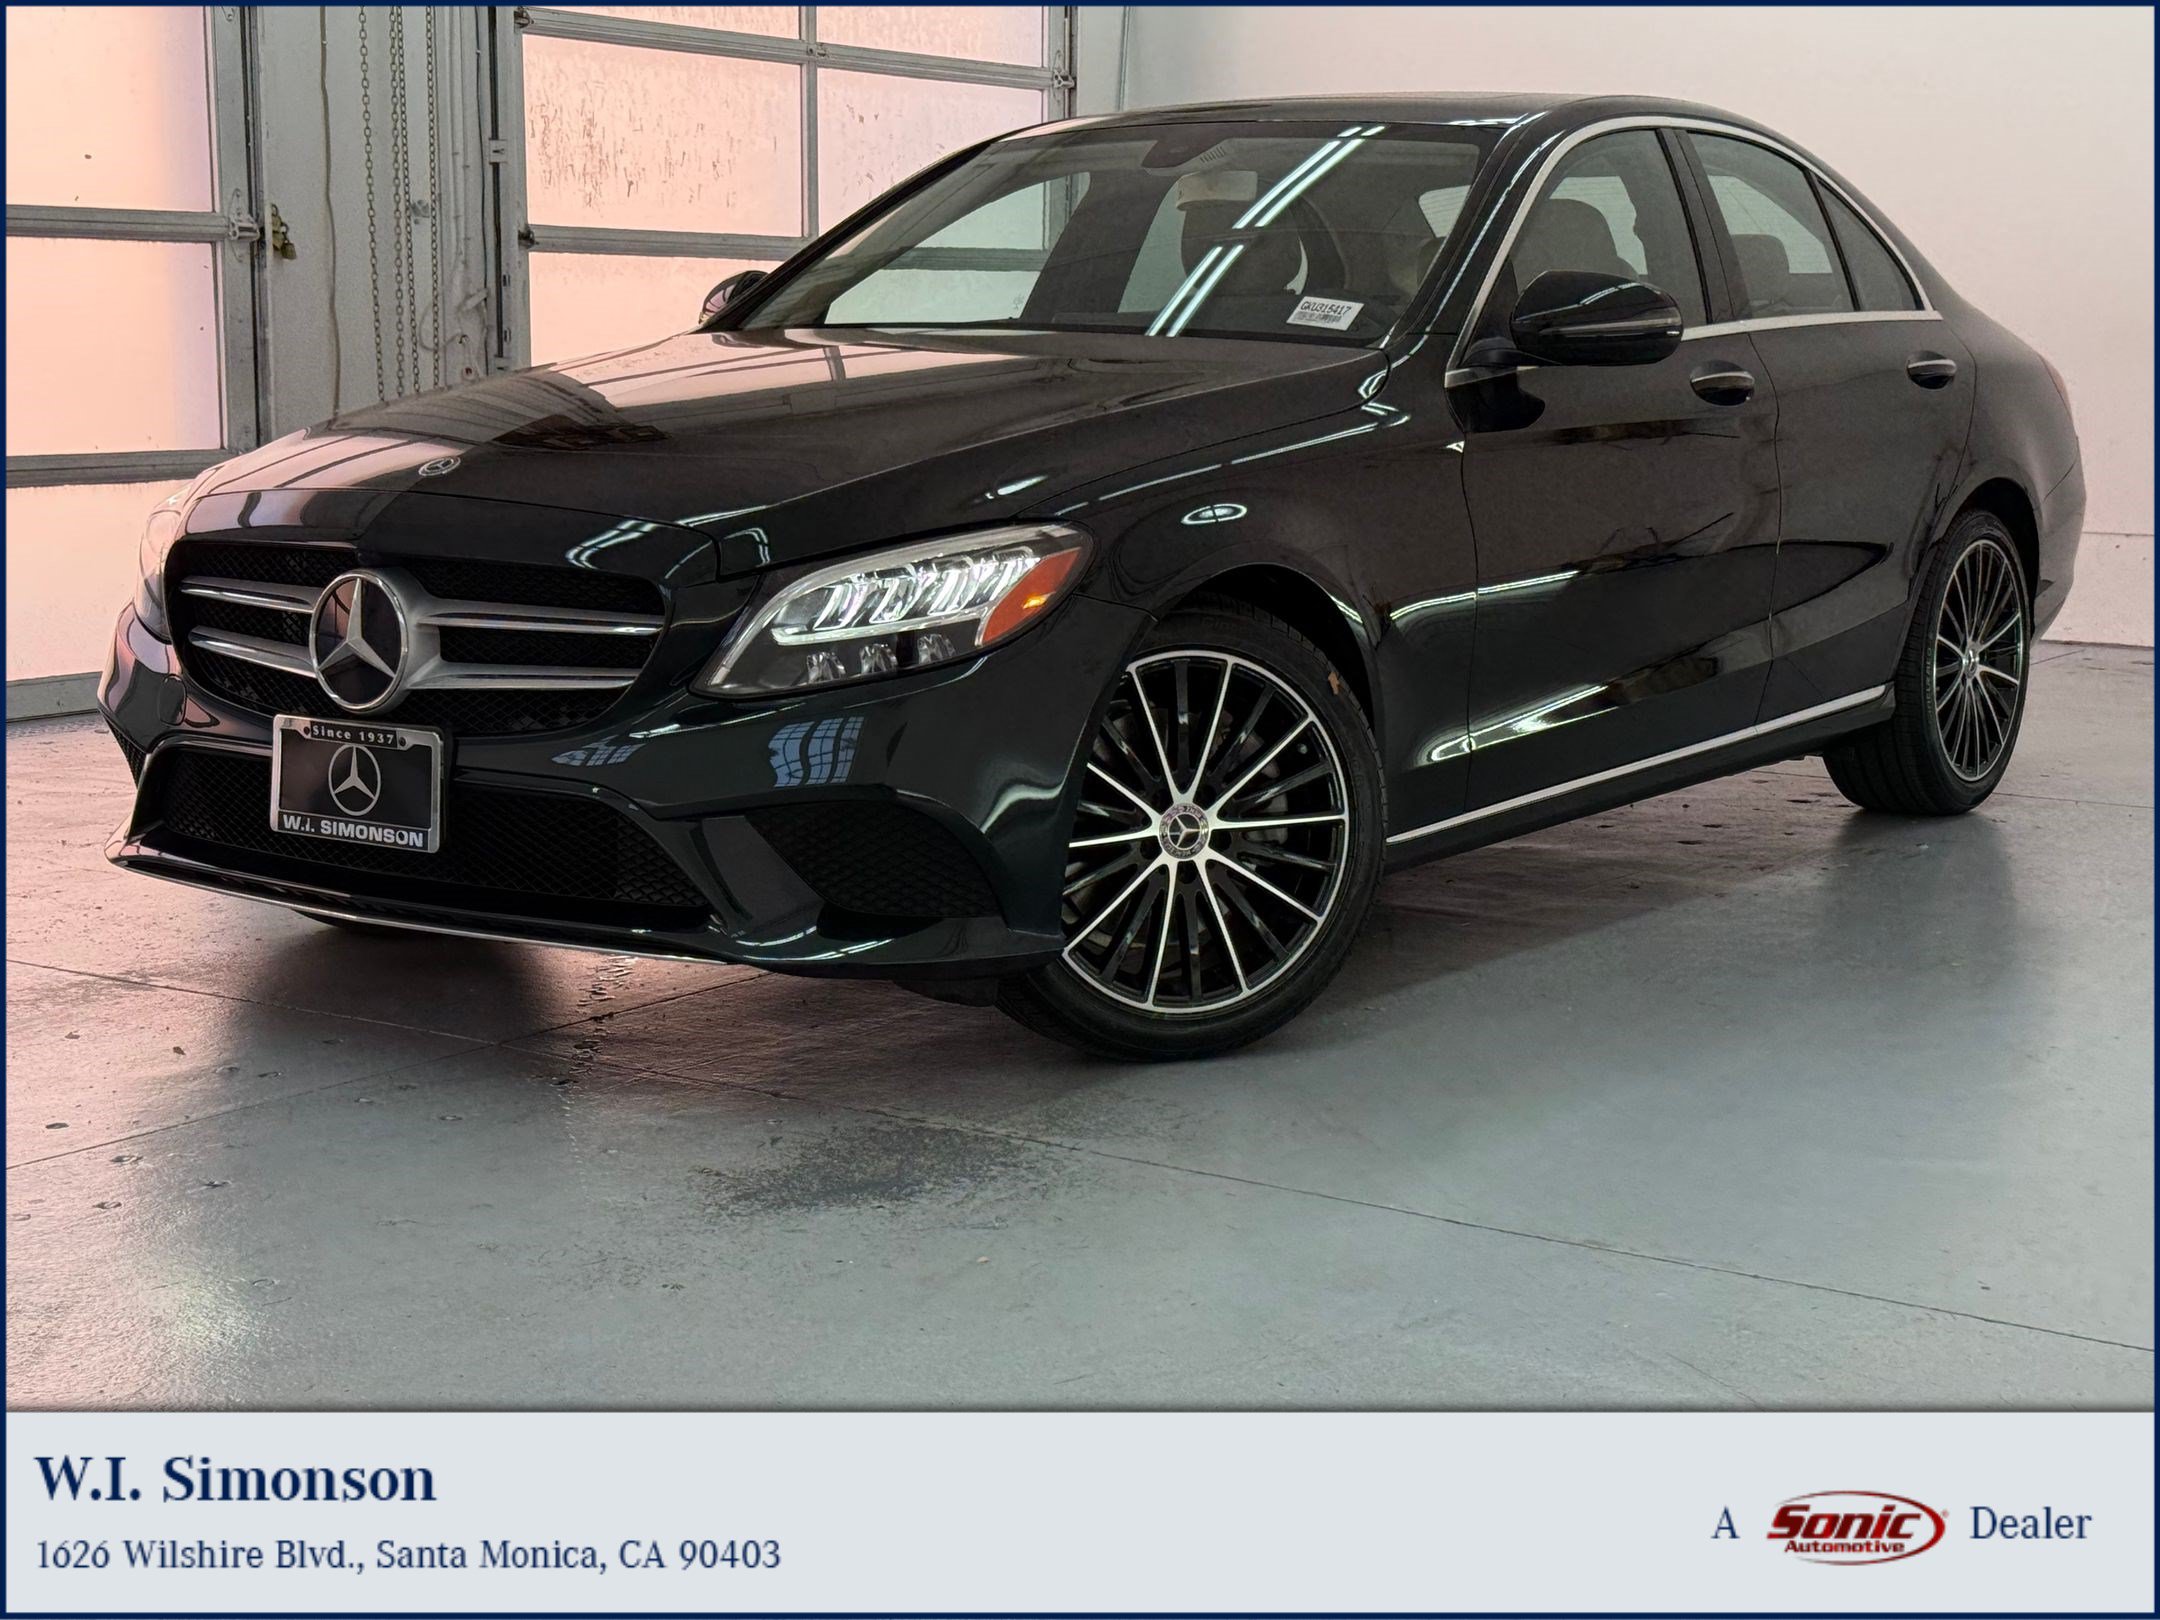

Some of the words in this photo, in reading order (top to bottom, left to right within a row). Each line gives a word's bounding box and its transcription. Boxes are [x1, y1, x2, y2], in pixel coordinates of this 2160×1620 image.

[312, 725, 351, 740] Since
[359, 731, 395, 745] 1937
[283, 814, 315, 833] W.I.
[320, 820, 424, 847] SIMONSON
